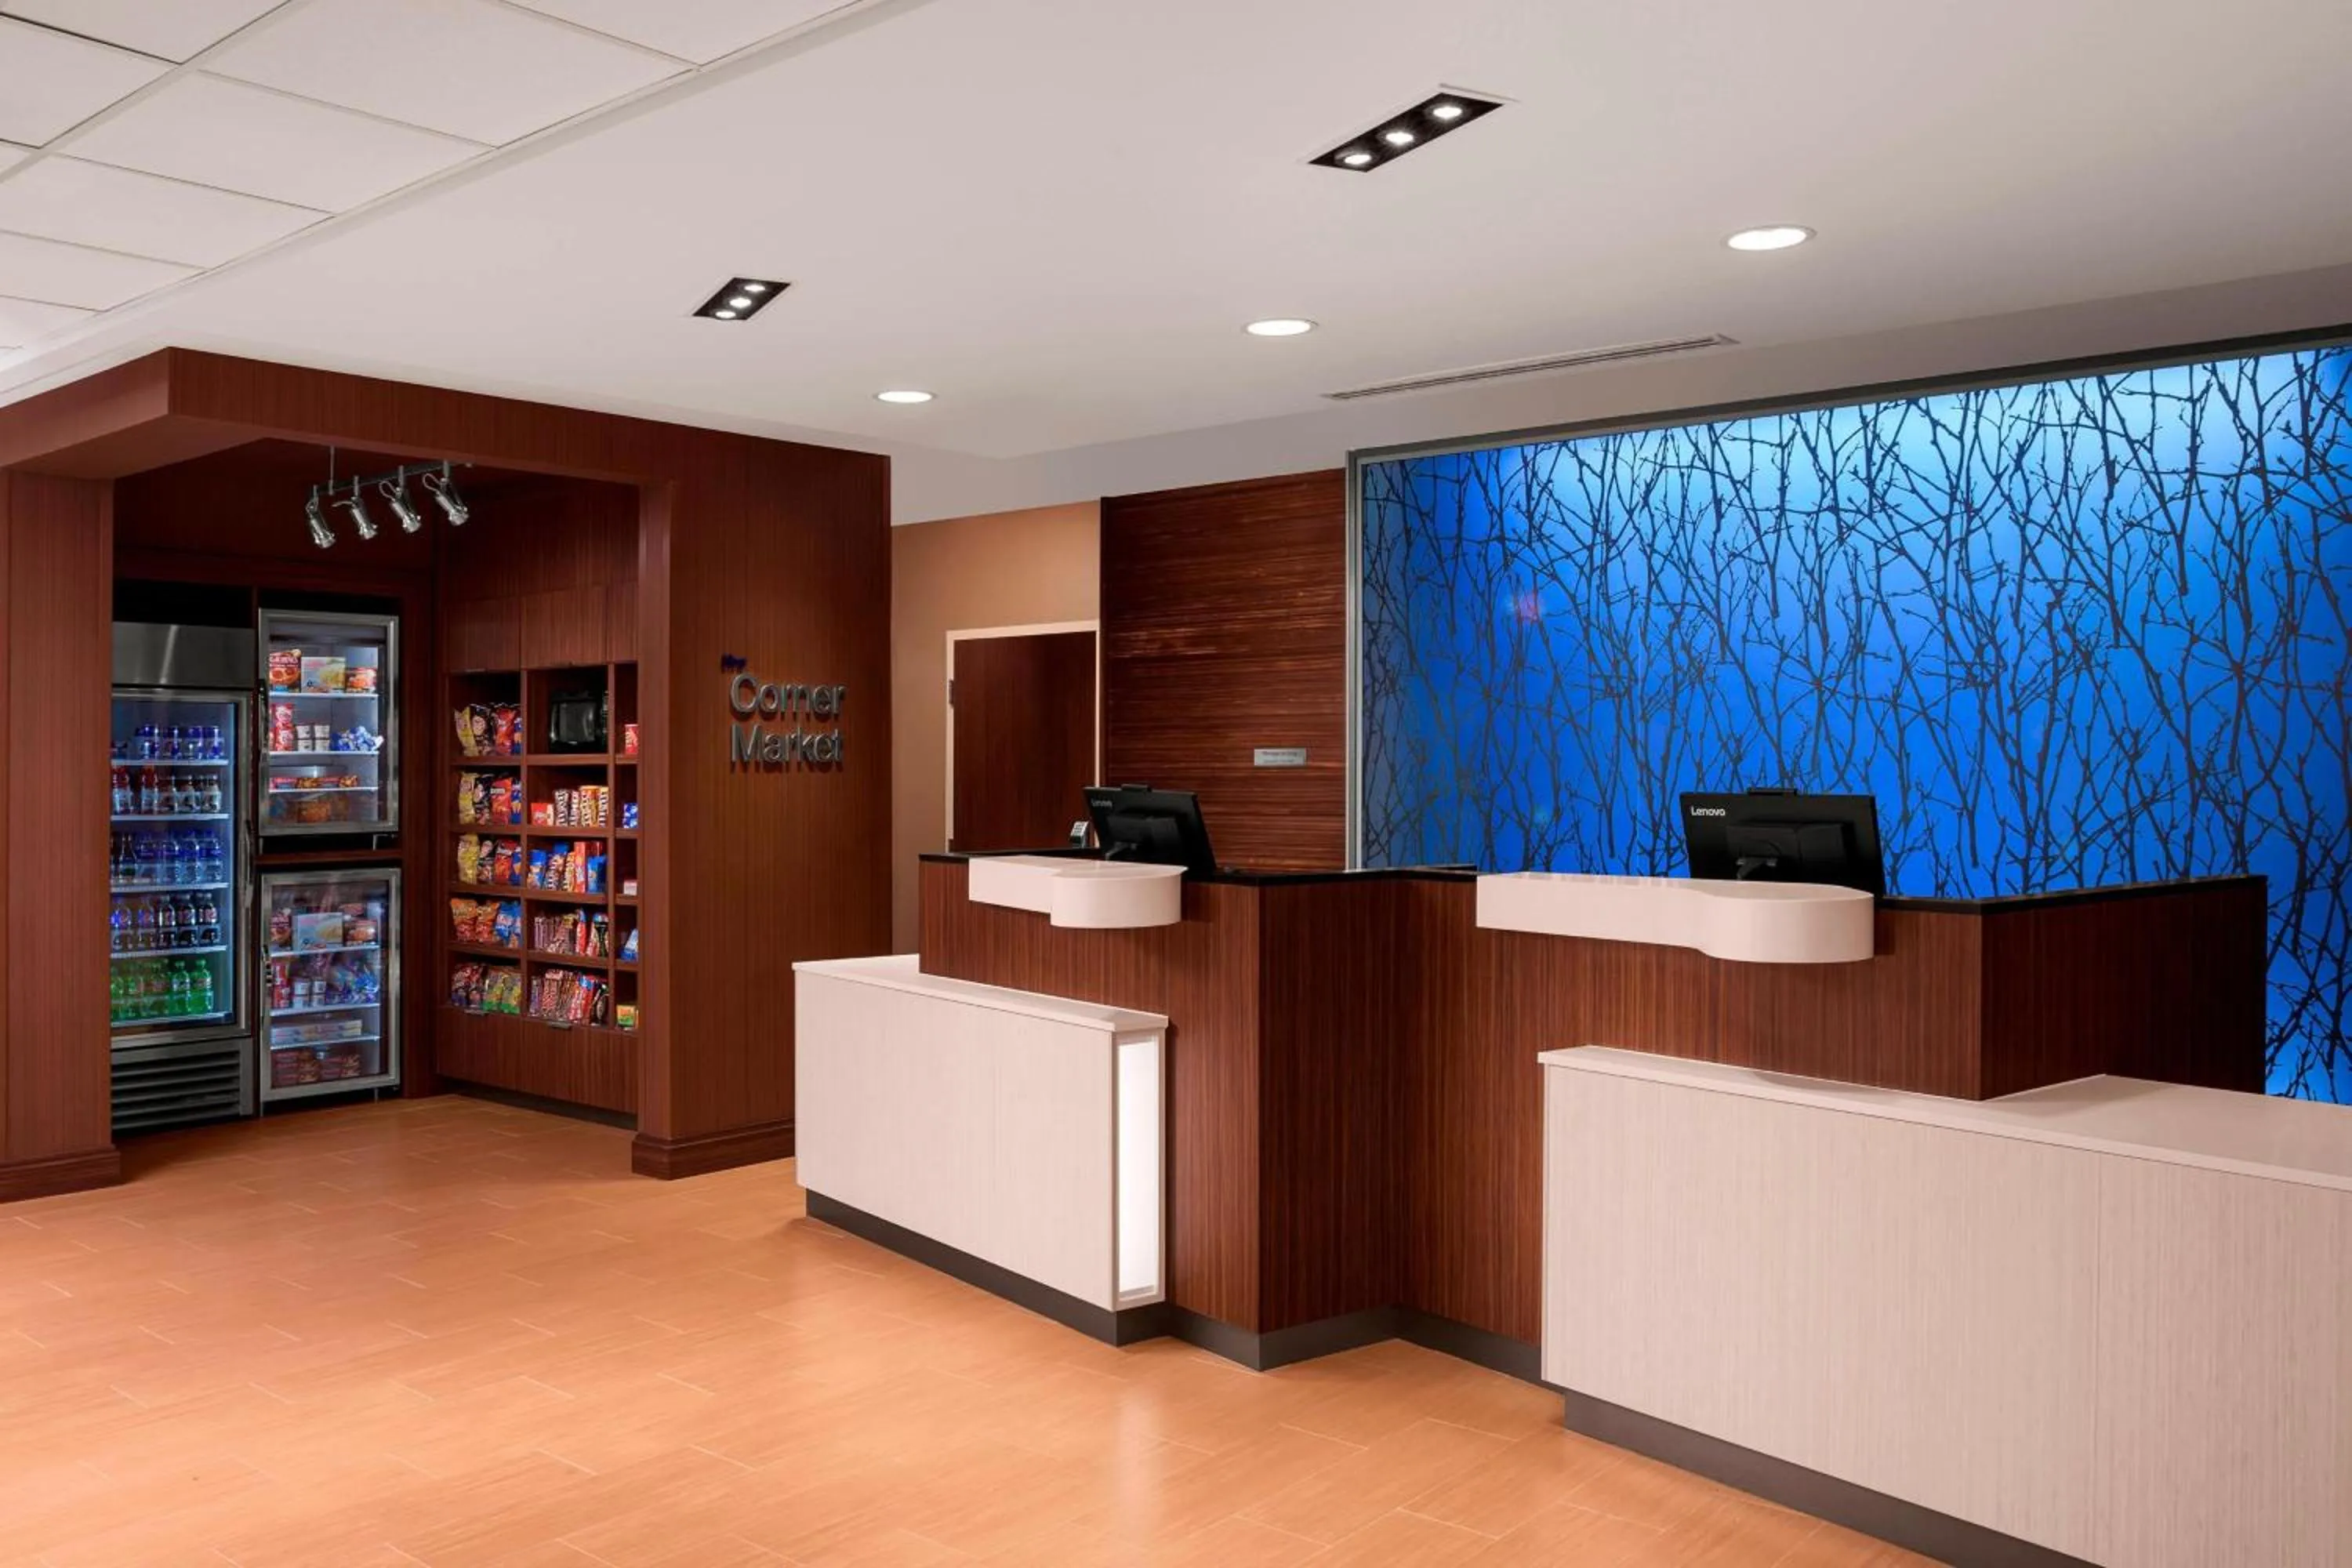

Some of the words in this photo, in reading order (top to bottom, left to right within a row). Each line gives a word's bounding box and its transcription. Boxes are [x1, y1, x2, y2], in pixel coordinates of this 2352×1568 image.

[730, 672, 847, 714] Corner
[731, 723, 844, 763] Market
[1690, 805, 1726, 816] Lenovo
